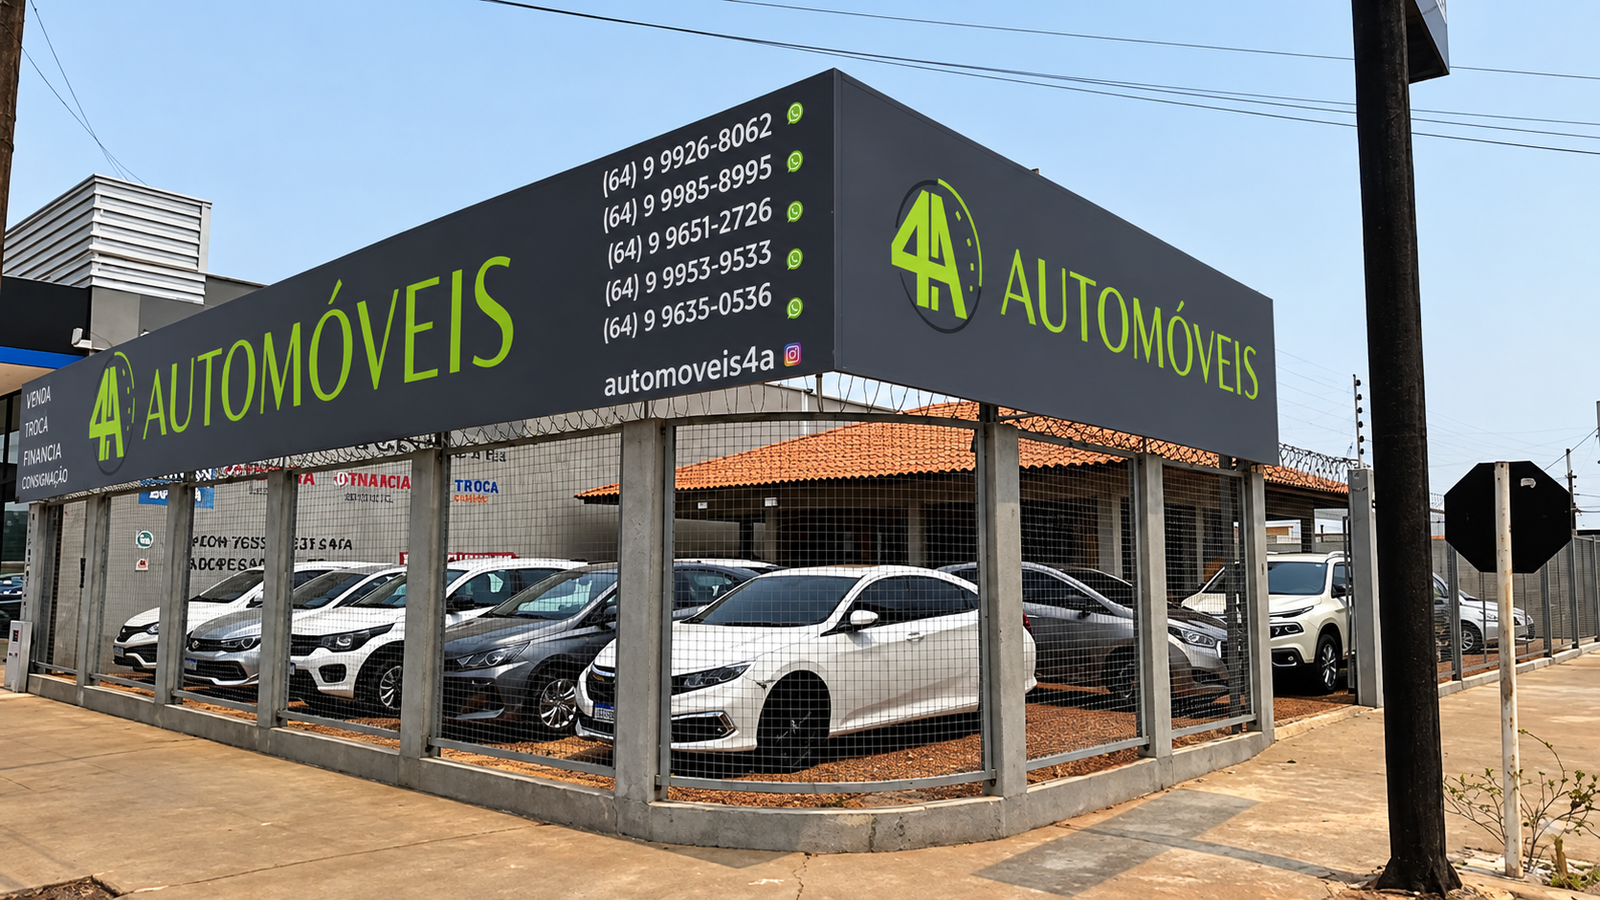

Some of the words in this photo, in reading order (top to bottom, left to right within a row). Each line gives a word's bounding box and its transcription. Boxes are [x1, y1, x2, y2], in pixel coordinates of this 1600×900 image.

[603, 160, 637, 199] (64)
[642, 156, 655, 180] 9
[660, 112, 772, 174] 9926-8062
[603, 197, 637, 234] (64)
[643, 194, 655, 218] 9
[660, 153, 773, 212] 9985-8995
[608, 234, 642, 270] (64)
[648, 231, 660, 255] 9
[665, 196, 773, 250] 9651-2726
[605, 273, 639, 308] (64)
[645, 271, 657, 294] 9
[662, 239, 772, 290] 9953-9533
[890, 188, 968, 320] 4A
[1000, 248, 1259, 400] AUTOMÓVEIS
[603, 311, 638, 345] (64)
[644, 309, 656, 332] 9
[661, 282, 772, 328] 9635-0536
[88, 365, 124, 462] 4A
[142, 255, 514, 440] AUTOMÓVEIS
[604, 345, 775, 397] automoveis4a
[25, 415, 48, 438] TROCA
[26, 385, 51, 409] VENDA
[21, 465, 68, 490] CONSIGNAÇÃO
[23, 442, 62, 467] FINANCIA
[454, 479, 499, 494] TROCA
